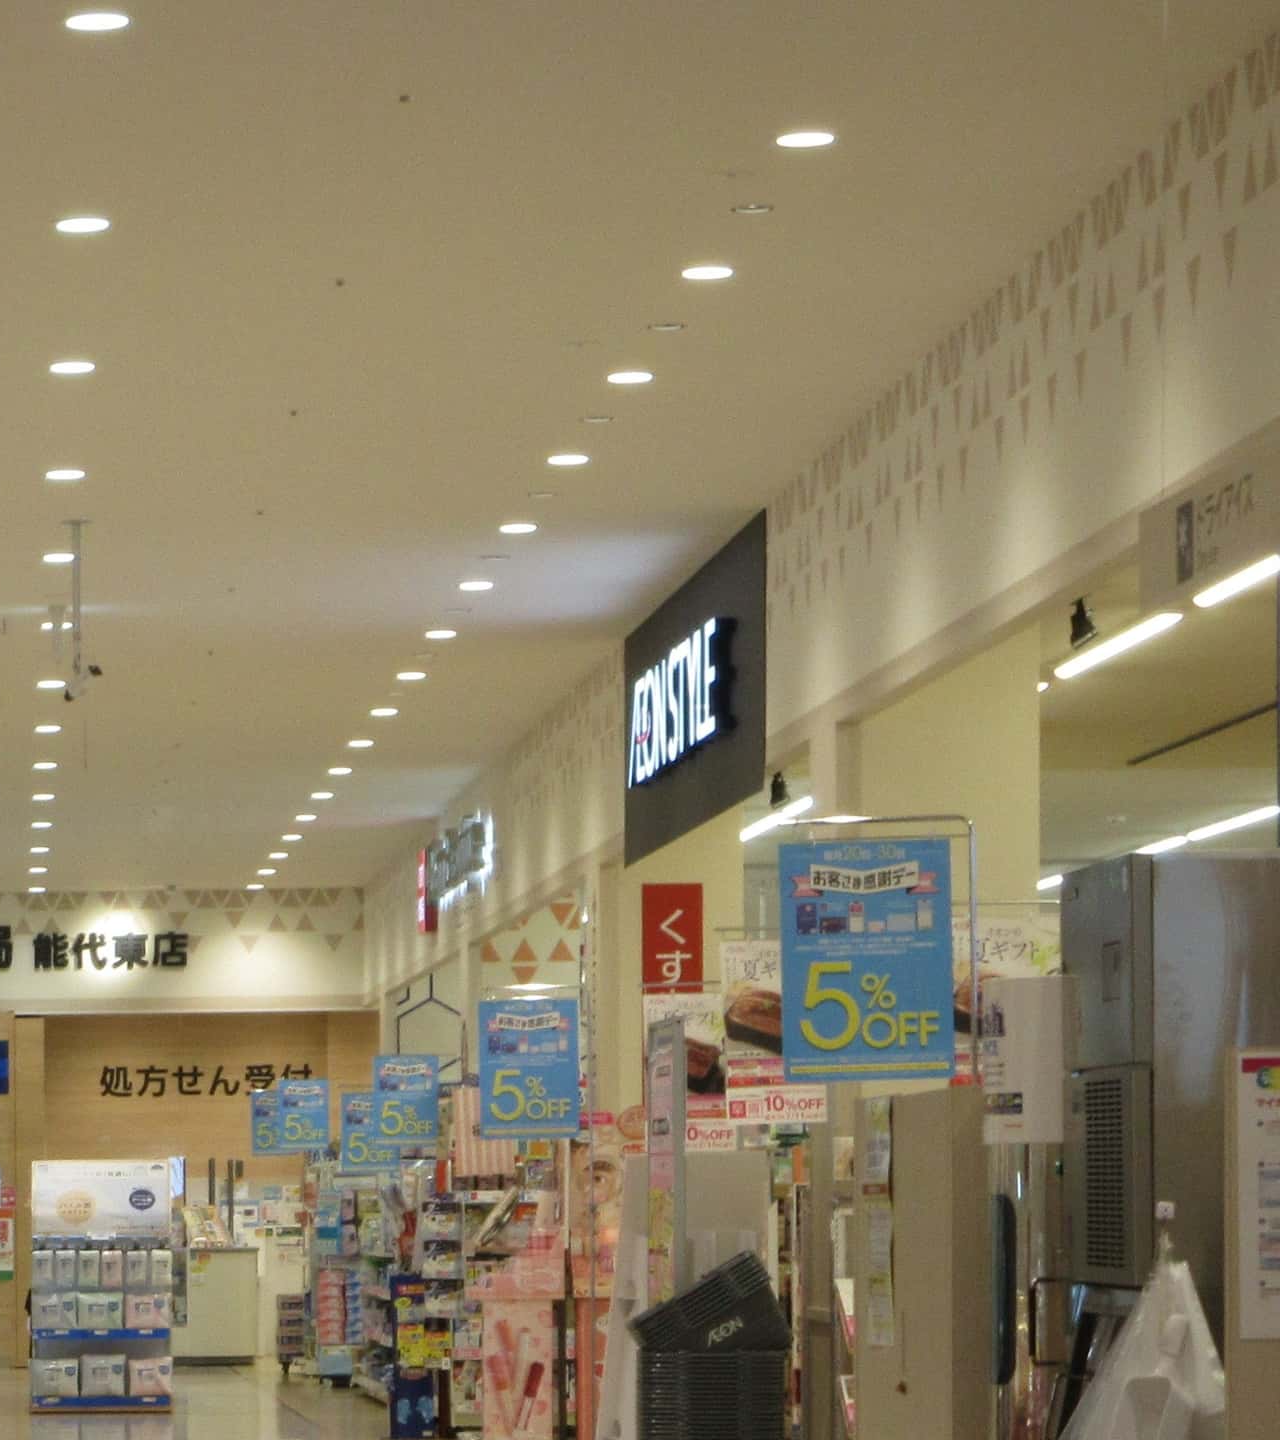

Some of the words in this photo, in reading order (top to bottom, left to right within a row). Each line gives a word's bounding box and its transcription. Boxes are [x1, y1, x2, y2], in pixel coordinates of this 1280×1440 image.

[667, 616, 717, 763] STYLE
[32, 930, 190, 971] 能代東店
[649, 908, 693, 993] くす
[862, 1010, 941, 1049] OFF
[402, 1120, 434, 1135] OFF
[526, 1098, 572, 1120] OFF
[686, 1123, 735, 1142] 0%OFF
